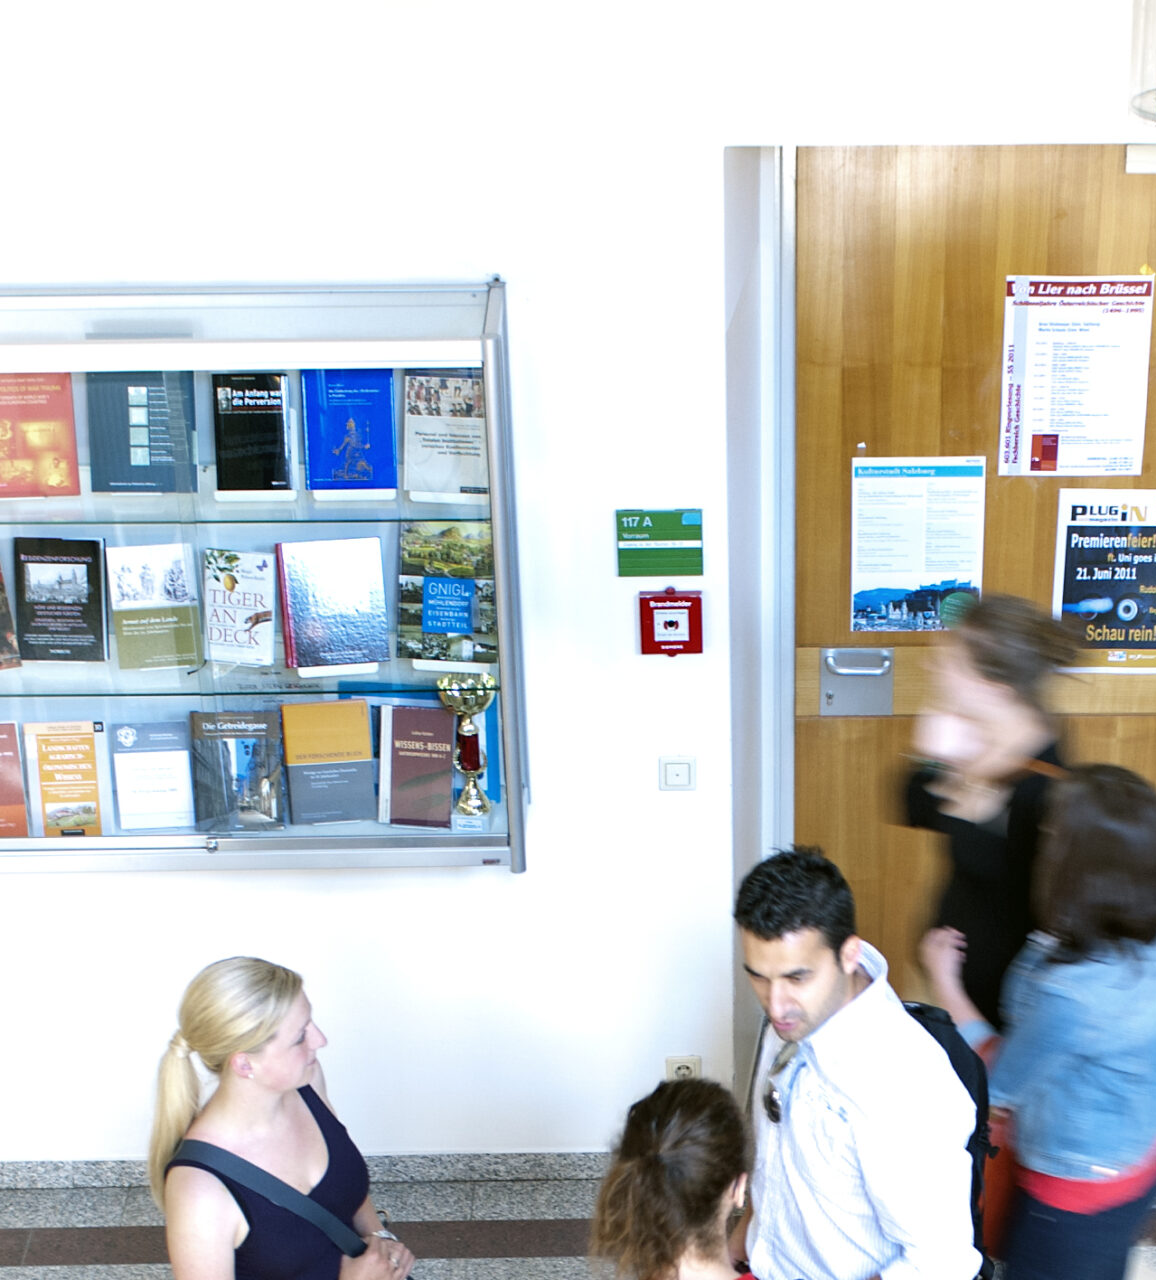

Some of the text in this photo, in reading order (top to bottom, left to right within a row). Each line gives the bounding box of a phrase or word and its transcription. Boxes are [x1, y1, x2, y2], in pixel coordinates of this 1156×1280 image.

[1038, 283, 1064, 294] Lier
[1066, 283, 1097, 295] nach
[1099, 282, 1148, 294] Brüssel
[232, 390, 244, 398] Am
[245, 390, 268, 398] Anfang
[232, 398, 282, 406] die Perversion
[622, 516, 653, 528] 117 A
[1070, 533, 1156, 548] Premierenfeier!
[1118, 553, 1132, 562] Uni
[1133, 555, 1152, 564] goes
[1076, 567, 1136, 580] 21. Juni 2011
[428, 582, 466, 596] GNIGL
[208, 589, 266, 608] TIGER
[208, 608, 237, 624] AN
[428, 610, 468, 618] EISENBAHN
[428, 620, 468, 629] STADTTEIL
[208, 626, 260, 646] DECK
[1086, 624, 1126, 642] Schau
[202, 722, 268, 732] Die Getreidegasse
[394, 740, 450, 752] WISSENS-BISSEN
